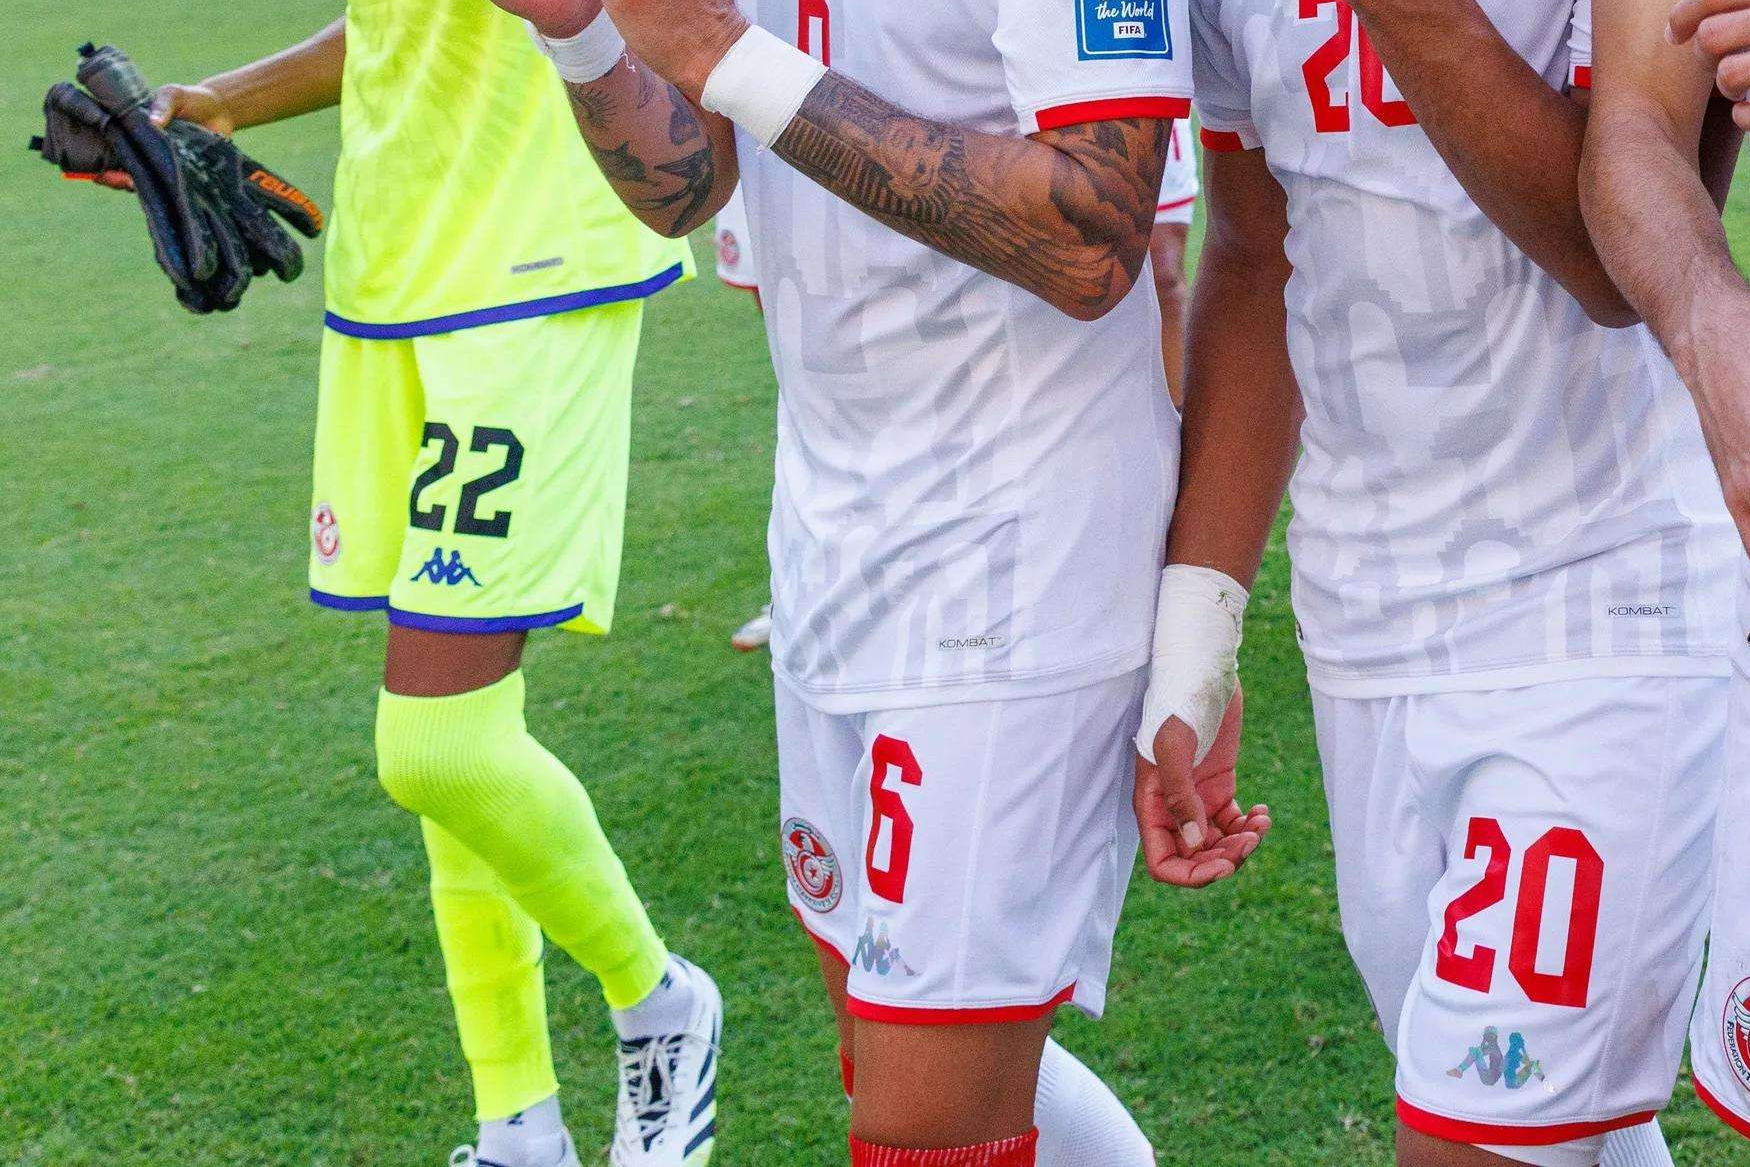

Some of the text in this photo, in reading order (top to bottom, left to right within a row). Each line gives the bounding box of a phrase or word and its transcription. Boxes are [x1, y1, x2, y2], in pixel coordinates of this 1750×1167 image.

[1095, 1, 1155, 21] the World
[1118, 25, 1142, 35] FIFA
[409, 421, 525, 539] 22
[1608, 606, 1671, 616] KOMBAT
[939, 637, 996, 648] KOMBAT
[866, 734, 923, 903] 6
[1436, 817, 1604, 1008] 20
